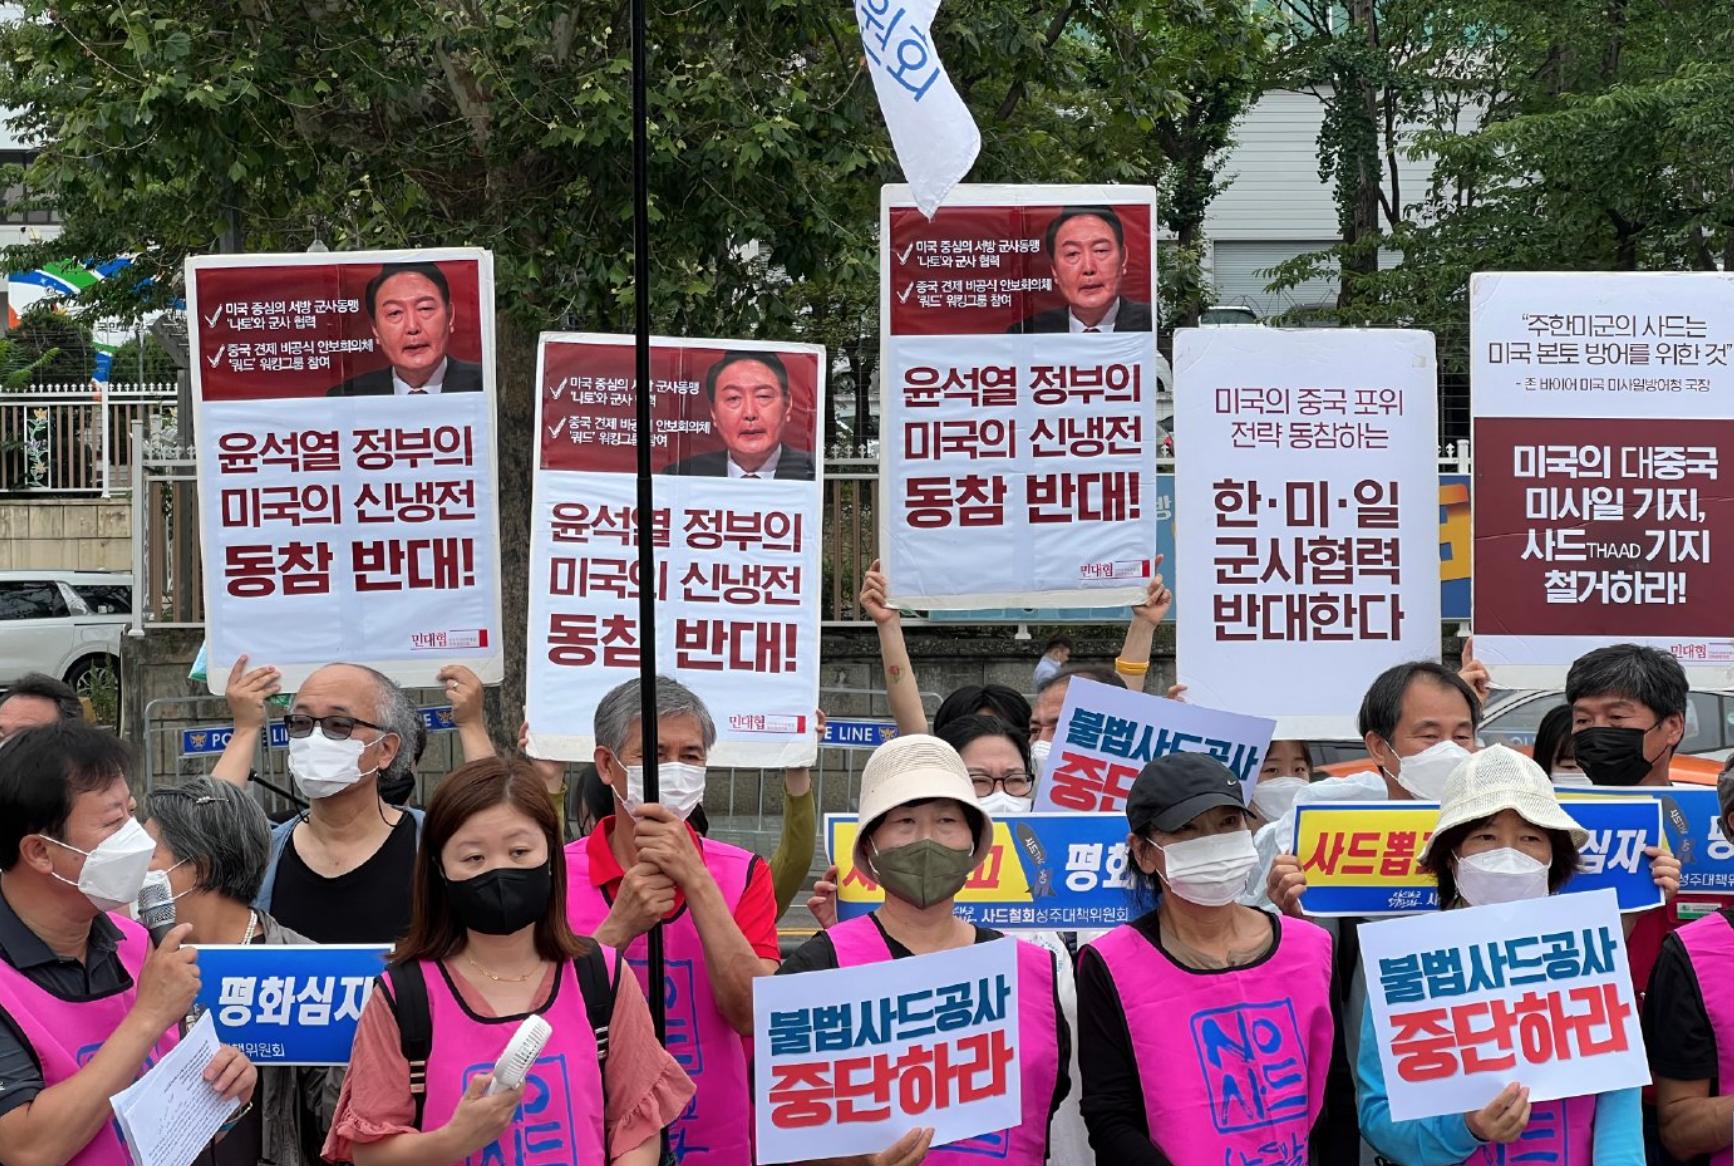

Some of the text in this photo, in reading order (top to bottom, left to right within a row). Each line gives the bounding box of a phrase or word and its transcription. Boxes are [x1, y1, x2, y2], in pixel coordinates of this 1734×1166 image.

[916, 240, 1040, 252] 미국 중심의 서방 군사동맹
[955, 256, 976, 267] 군사
[979, 255, 1000, 267] 협력
[916, 278, 1052, 292] 중국 견제 비공식 안보회의체
[946, 295, 987, 307] 워킹그룹
[990, 294, 1011, 306] 참여
[226, 299, 359, 316] 미국 중심의 서방 군사동맹
[269, 318, 292, 330] 군사
[294, 316, 316, 329] 협력
[1642, 315, 1707, 338] 사드는
[228, 339, 374, 358] 중국 견제 비공식 안보회의체
[260, 358, 304, 372] 워킹그룹
[307, 356, 330, 370] 참여
[1488, 342, 1531, 365] 미국
[1536, 343, 1580, 365] 본토
[1586, 343, 1650, 366] 방어를
[1656, 343, 1701, 366] 위한
[570, 377, 592, 390] 미국
[595, 378, 628, 390] 중심의
[656, 380, 700, 394] 군사동맹
[610, 394, 632, 406] 군사
[904, 364, 1141, 407] 윤석열 정부의
[1215, 388, 1403, 416] 미국의 중국 포위
[1525, 378, 1536, 392] 존
[1540, 378, 1577, 392] 바이어
[1580, 378, 1606, 392] 미국
[1608, 378, 1682, 392] 미사일방어청
[1686, 378, 1710, 393] 국장
[568, 416, 592, 428] 중국
[596, 418, 618, 430] 견제
[656, 420, 711, 434] 안보회의체
[904, 416, 1142, 460] 미국의 신냉전
[1231, 422, 1389, 449] 전략 동참하는
[218, 425, 473, 474] 윤석열 정부의
[1513, 444, 1719, 481] 미국의 대중국
[222, 480, 474, 528] 미국의 신냉전
[905, 472, 1140, 529] 동참 반대!
[1212, 478, 1400, 528] 한·미·일
[1526, 487, 1706, 523] 미사일 기지,
[551, 502, 802, 553] 윤석열 정부의
[1214, 536, 1400, 586] 군사협력
[1644, 530, 1710, 564] 기지
[224, 538, 474, 598] 동참 반대!
[680, 562, 801, 606] 신냉전
[1544, 570, 1687, 606] 철거하라!
[1213, 592, 1405, 642] 반대한다
[675, 618, 798, 674] 반대!
[730, 714, 765, 730] 민대협
[840, 727, 872, 742] LINE
[1379, 926, 1618, 1005] 불법사드공사
[768, 974, 1011, 1056] 불법사드공사
[1390, 983, 1631, 1083] 중단하라
[768, 1029, 1014, 1129] 중단하라
